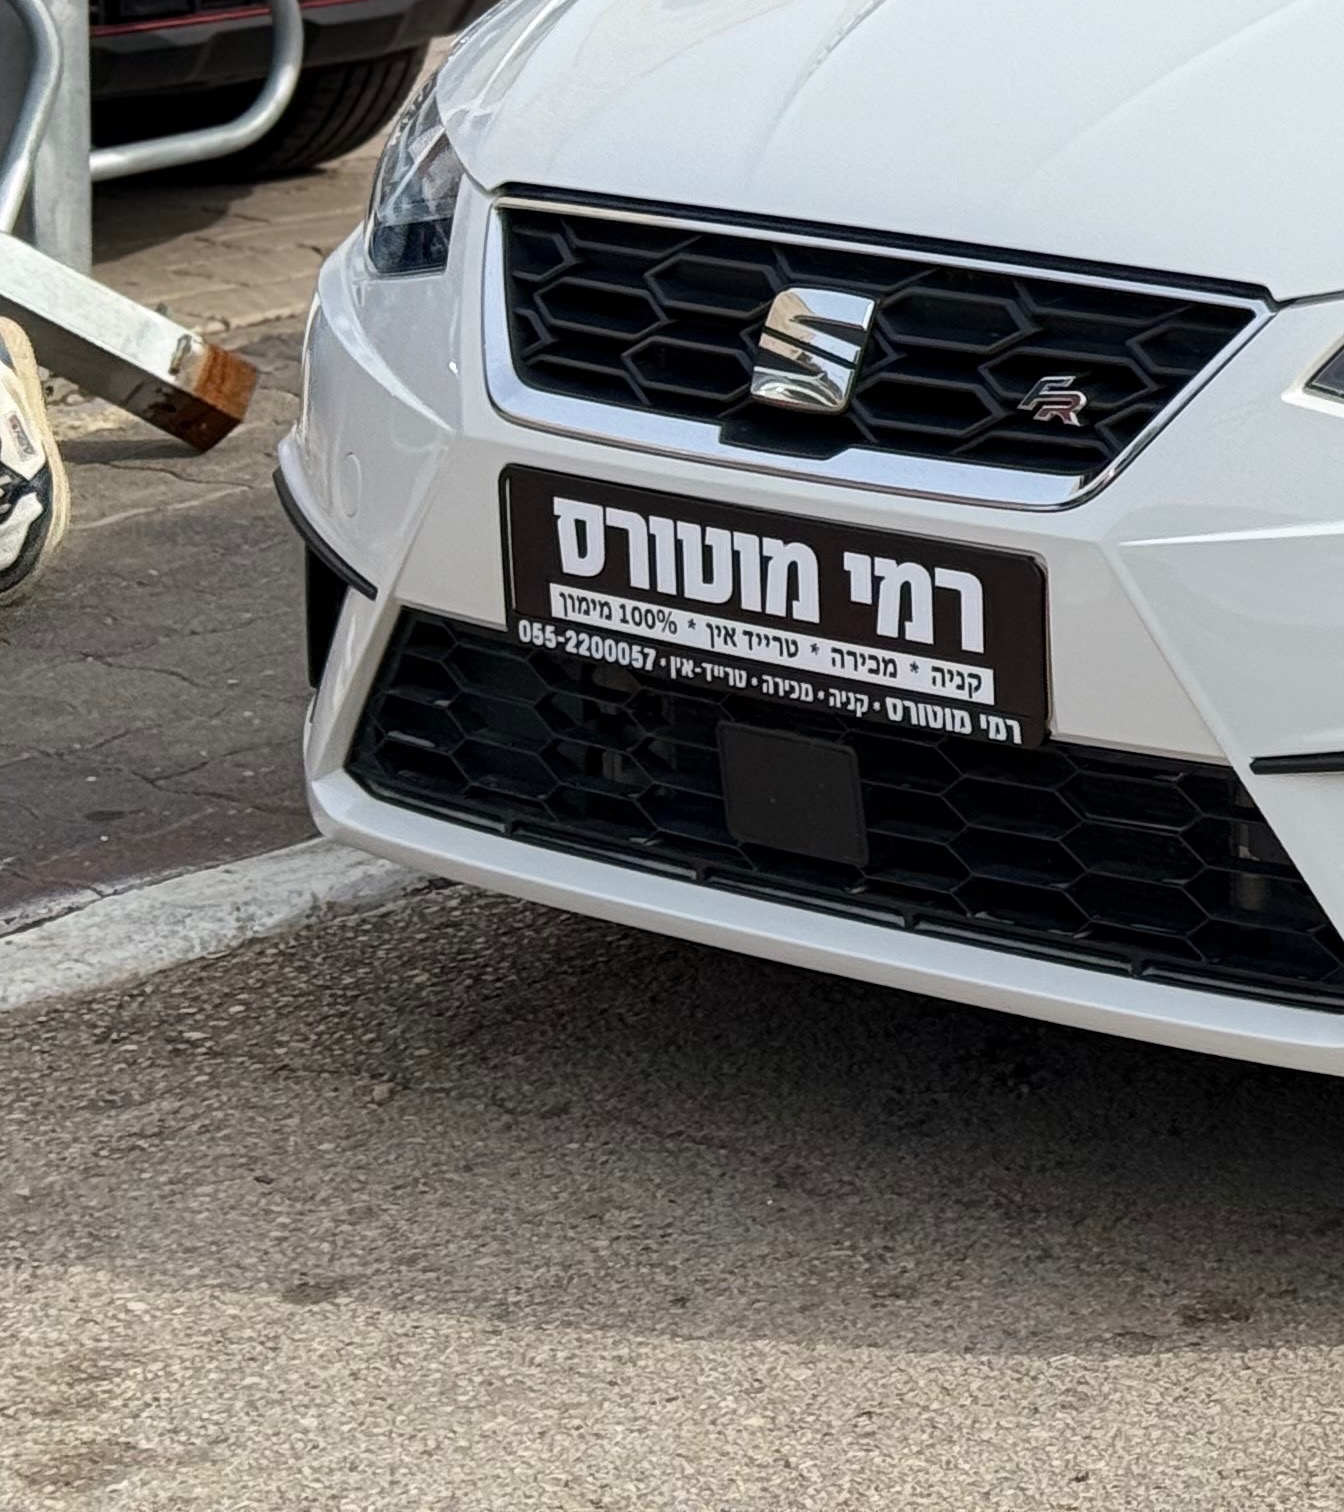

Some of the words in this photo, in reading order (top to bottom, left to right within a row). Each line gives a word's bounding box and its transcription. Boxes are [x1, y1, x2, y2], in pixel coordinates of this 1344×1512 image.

[553, 497, 820, 625] מוטורס
[559, 591, 612, 622] מימון
[843, 551, 985, 654] רמי
[618, 603, 678, 635] 100%
[705, 621, 737, 649] אין
[518, 619, 657, 671] 055-2200057
[742, 628, 799, 659] טרייד
[669, 654, 747, 688] טרייד-אין
[831, 647, 898, 679] מכירה
[761, 674, 814, 703] מכירה
[931, 664, 982, 699] קניה
[828, 688, 869, 718] קניה
[885, 696, 973, 735] מוטורס
[979, 713, 1023, 745] רמי
